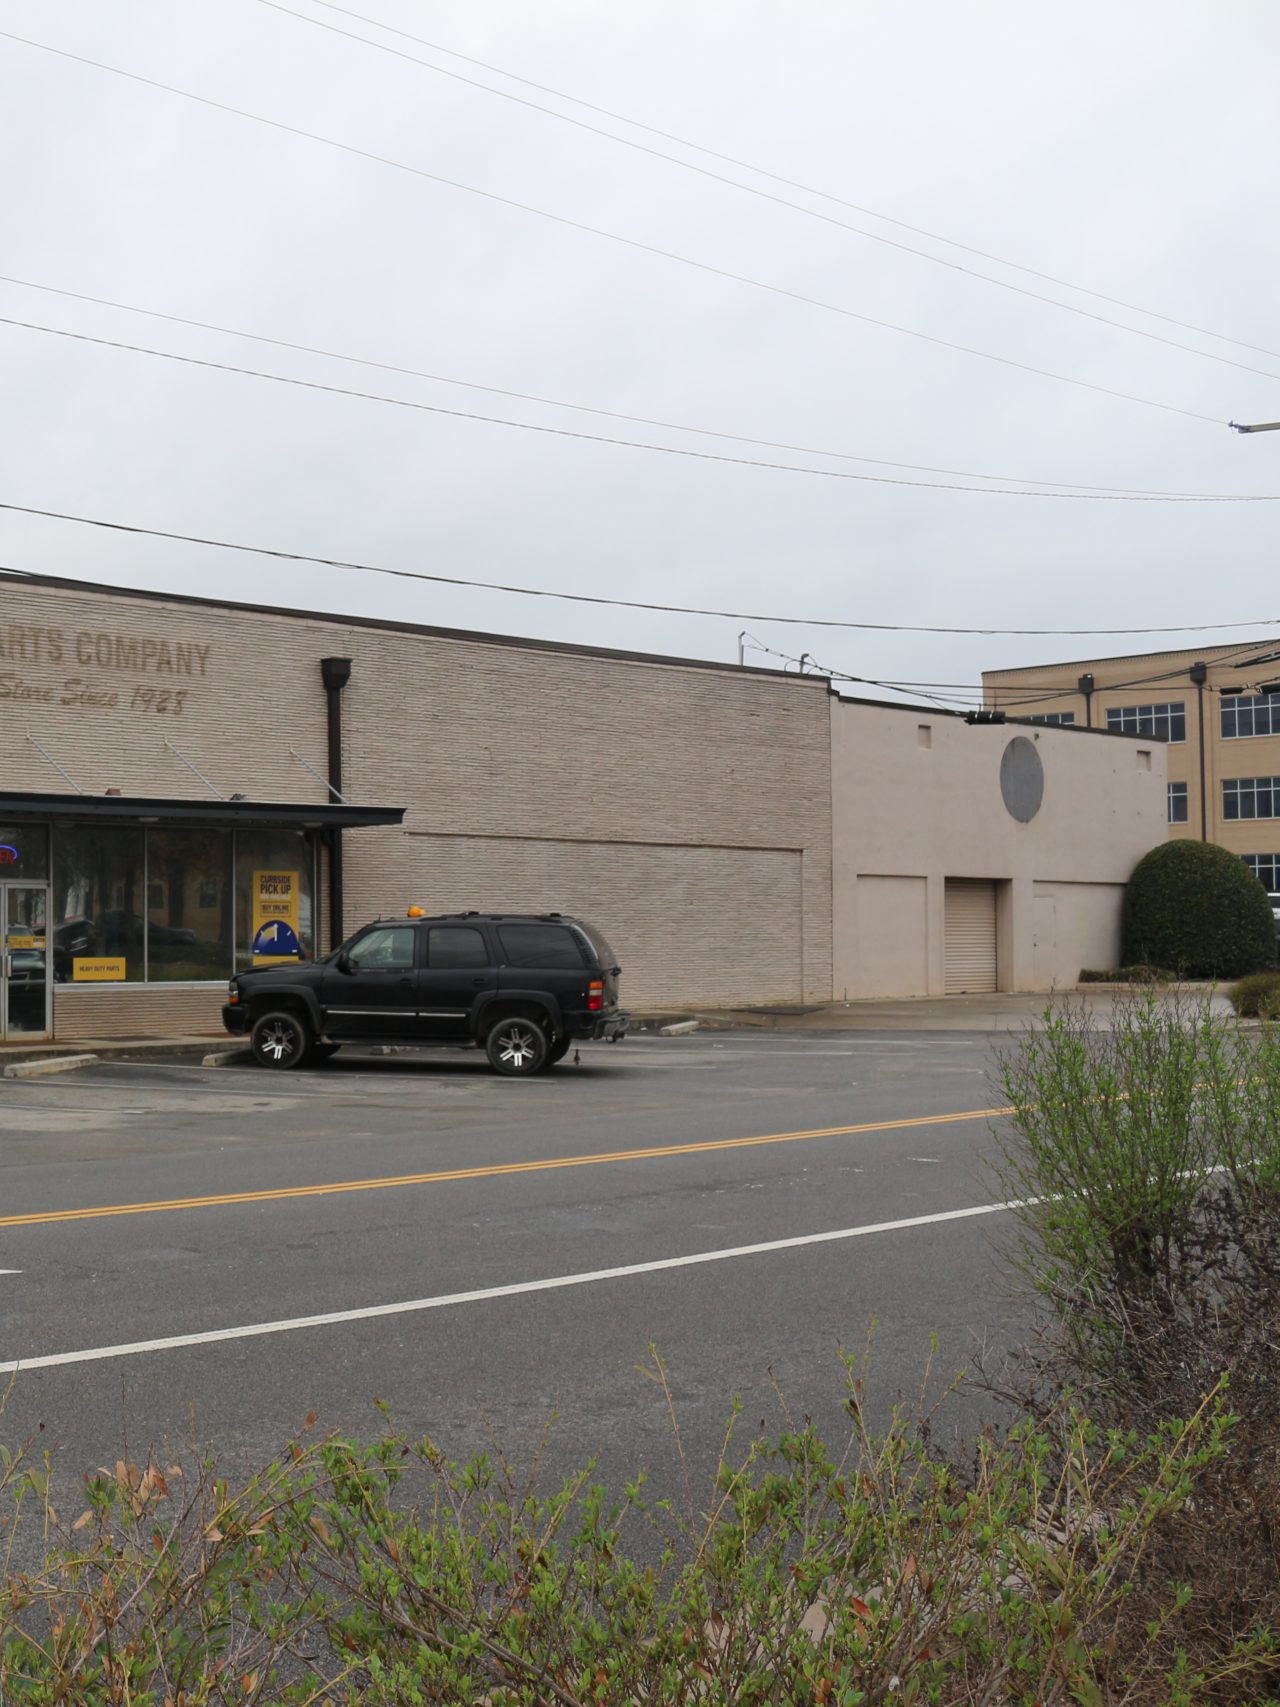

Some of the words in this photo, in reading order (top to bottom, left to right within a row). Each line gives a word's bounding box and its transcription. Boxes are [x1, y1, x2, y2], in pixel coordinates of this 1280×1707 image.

[75, 629, 211, 676] COMPANY
[60, 678, 118, 708] Since
[260, 875, 291, 884] CURBSIDE
[260, 884, 279, 895] PICK
[281, 884, 292, 895] UP
